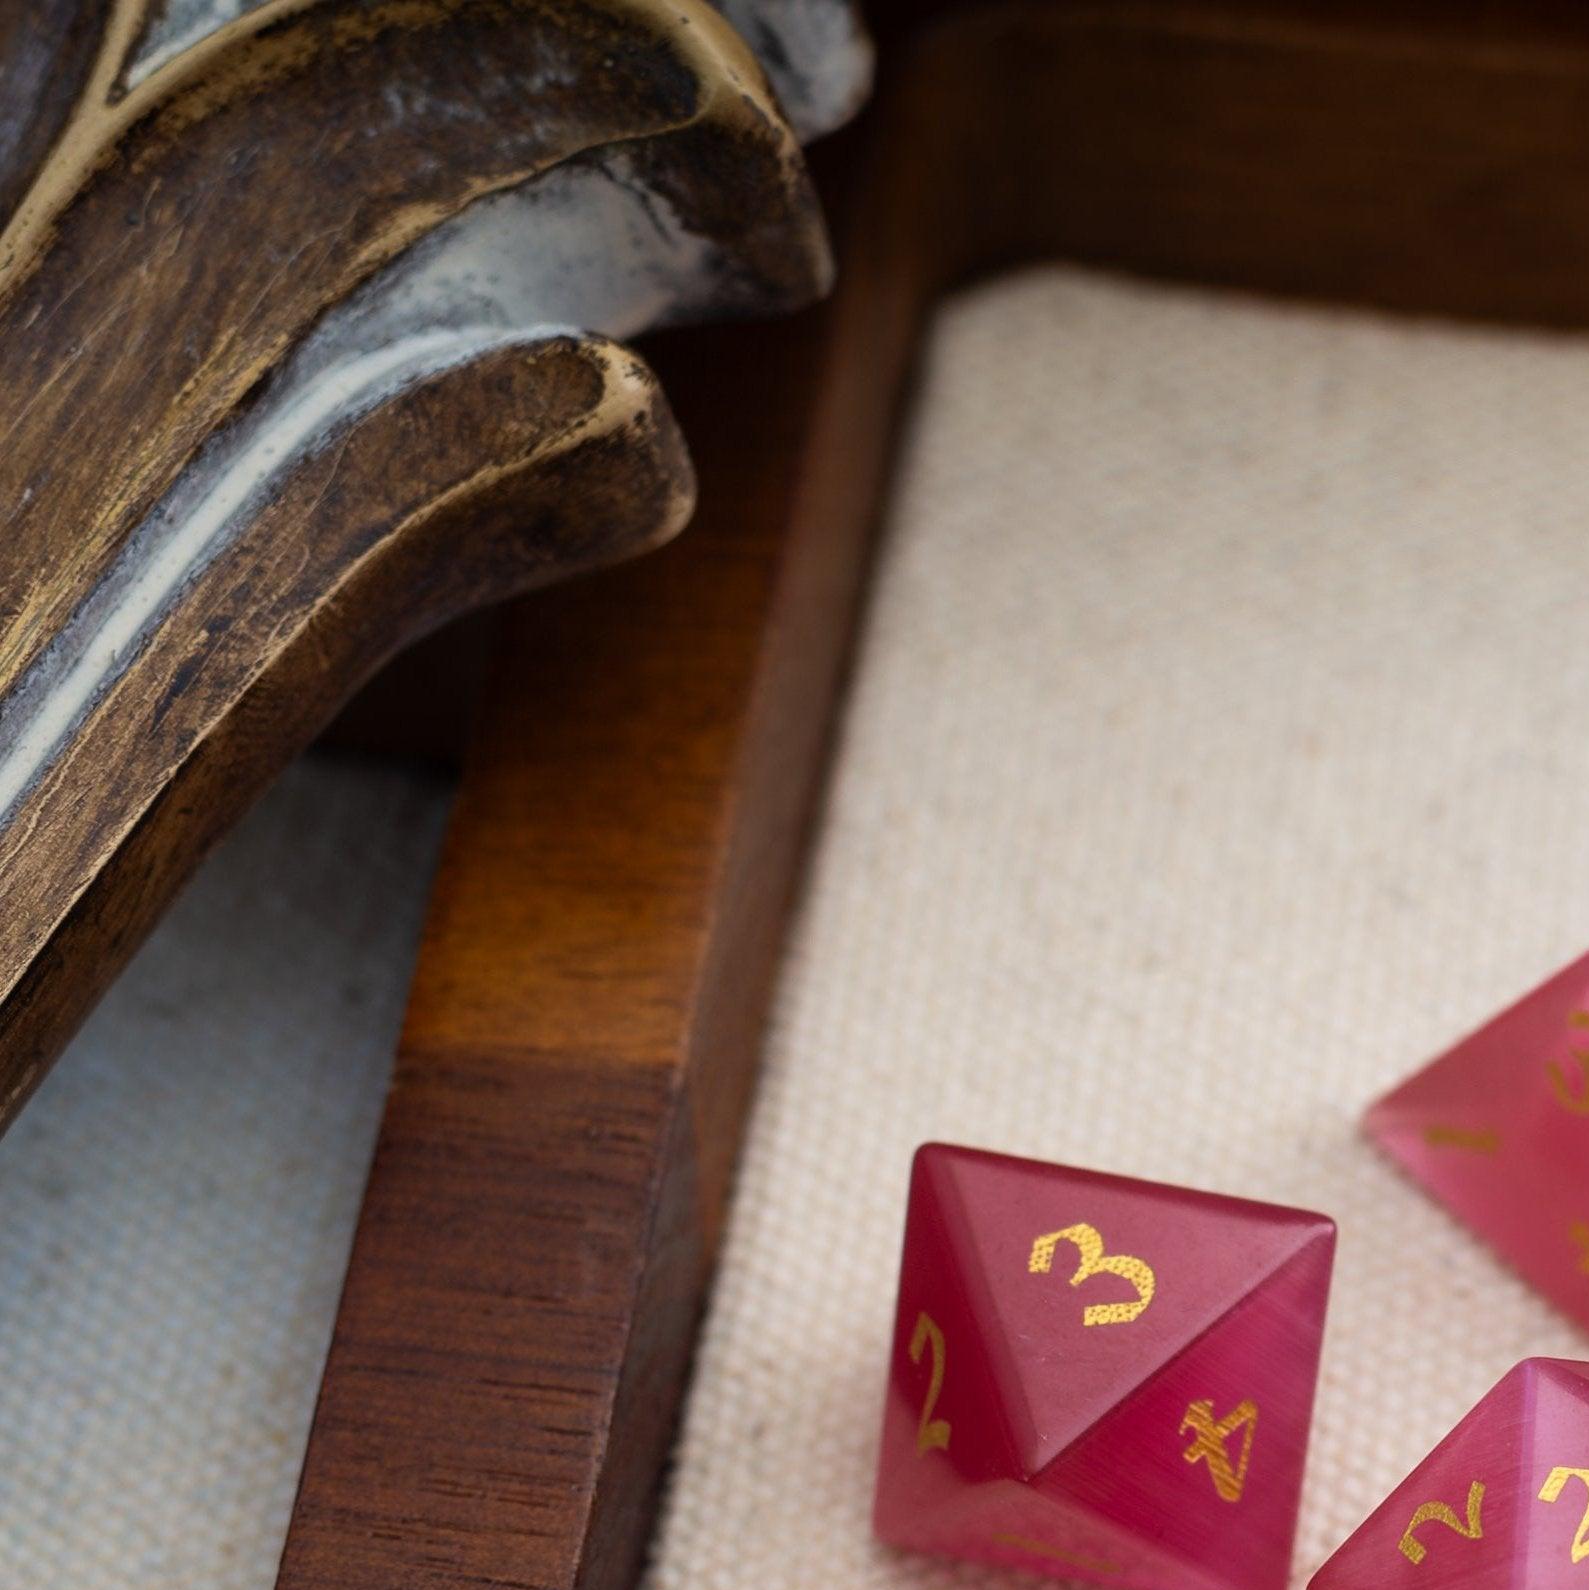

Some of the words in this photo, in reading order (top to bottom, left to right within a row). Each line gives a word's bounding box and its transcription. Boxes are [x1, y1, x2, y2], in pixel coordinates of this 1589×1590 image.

[1028, 1222, 1155, 1326] 3
[909, 1311, 951, 1459] 2
[1178, 1399, 1257, 1503] 4
[1398, 1480, 1486, 1565] 2
